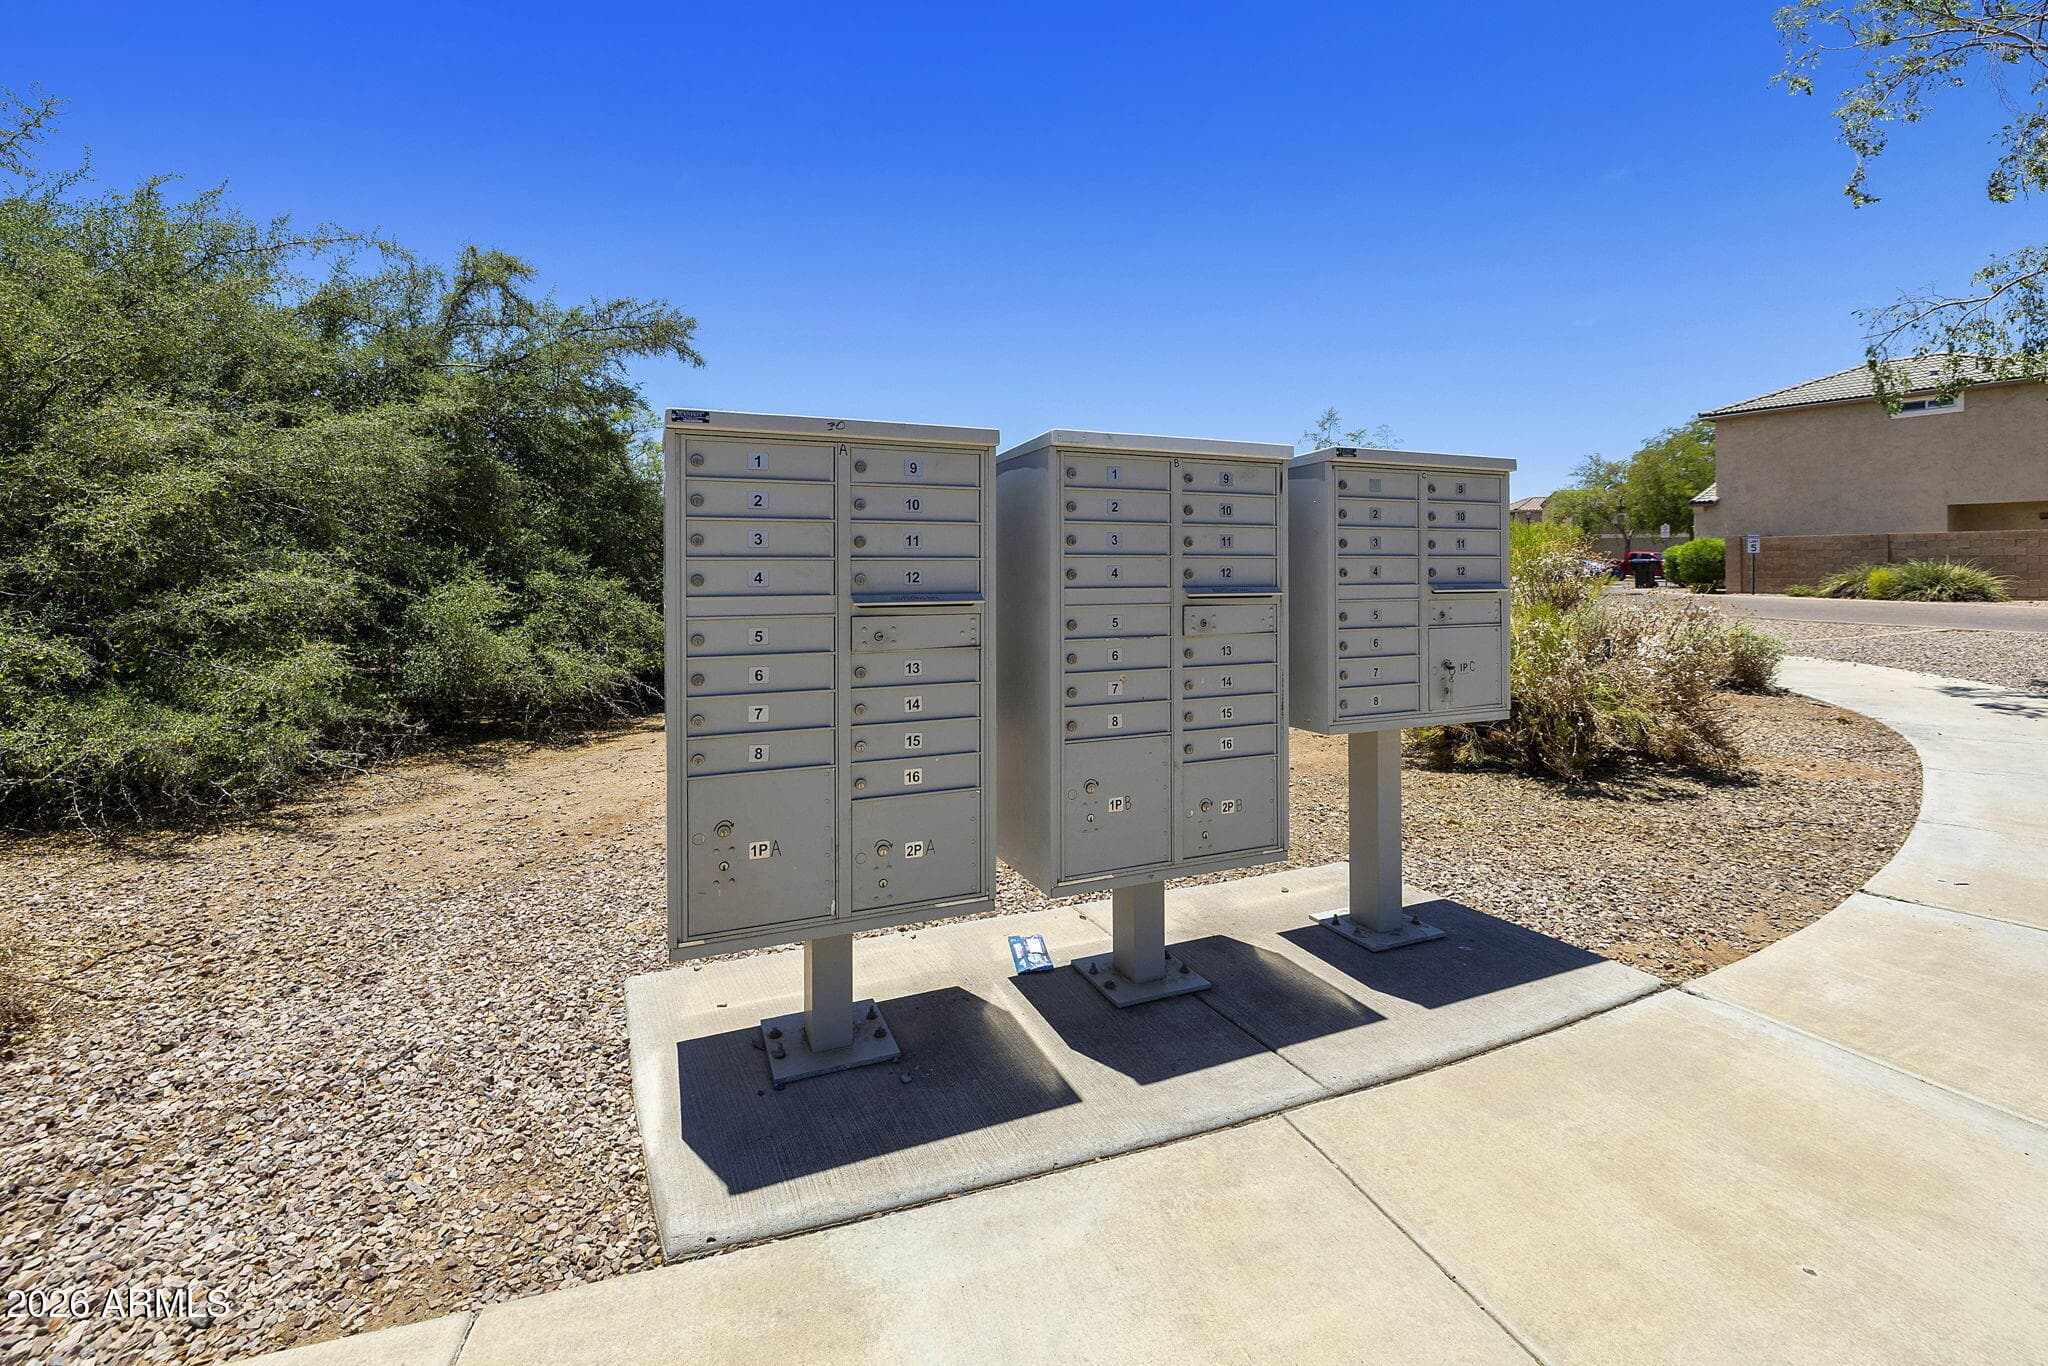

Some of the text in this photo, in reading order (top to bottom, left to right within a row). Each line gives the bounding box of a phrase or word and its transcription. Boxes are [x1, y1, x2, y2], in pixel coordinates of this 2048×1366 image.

[826, 420, 846, 432] 30
[838, 443, 848, 456] A
[909, 462, 918, 474] 9
[753, 494, 763, 507] 2
[905, 498, 920, 511] 10
[1220, 505, 1232, 516] 10
[754, 533, 763, 546] 3
[905, 535, 919, 547] 11
[1221, 536, 1231, 547] 11
[1750, 543, 1757, 552] 5
[753, 571, 764, 584] 4
[905, 571, 920, 584] 12
[1220, 567, 1232, 578] 12
[754, 630, 763, 643] 5
[1221, 645, 1232, 656] 13
[905, 662, 920, 674] 13
[754, 669, 764, 682] 6
[1221, 676, 1233, 687] 14
[905, 698, 921, 711] 14
[754, 707, 763, 720] 7
[1221, 707, 1233, 719] 15
[905, 735, 921, 748] 15
[1221, 739, 1233, 750] 16
[754, 747, 763, 760] 8
[905, 770, 920, 784] 16
[750, 843, 768, 857] 1P
[906, 844, 922, 857] 2P
